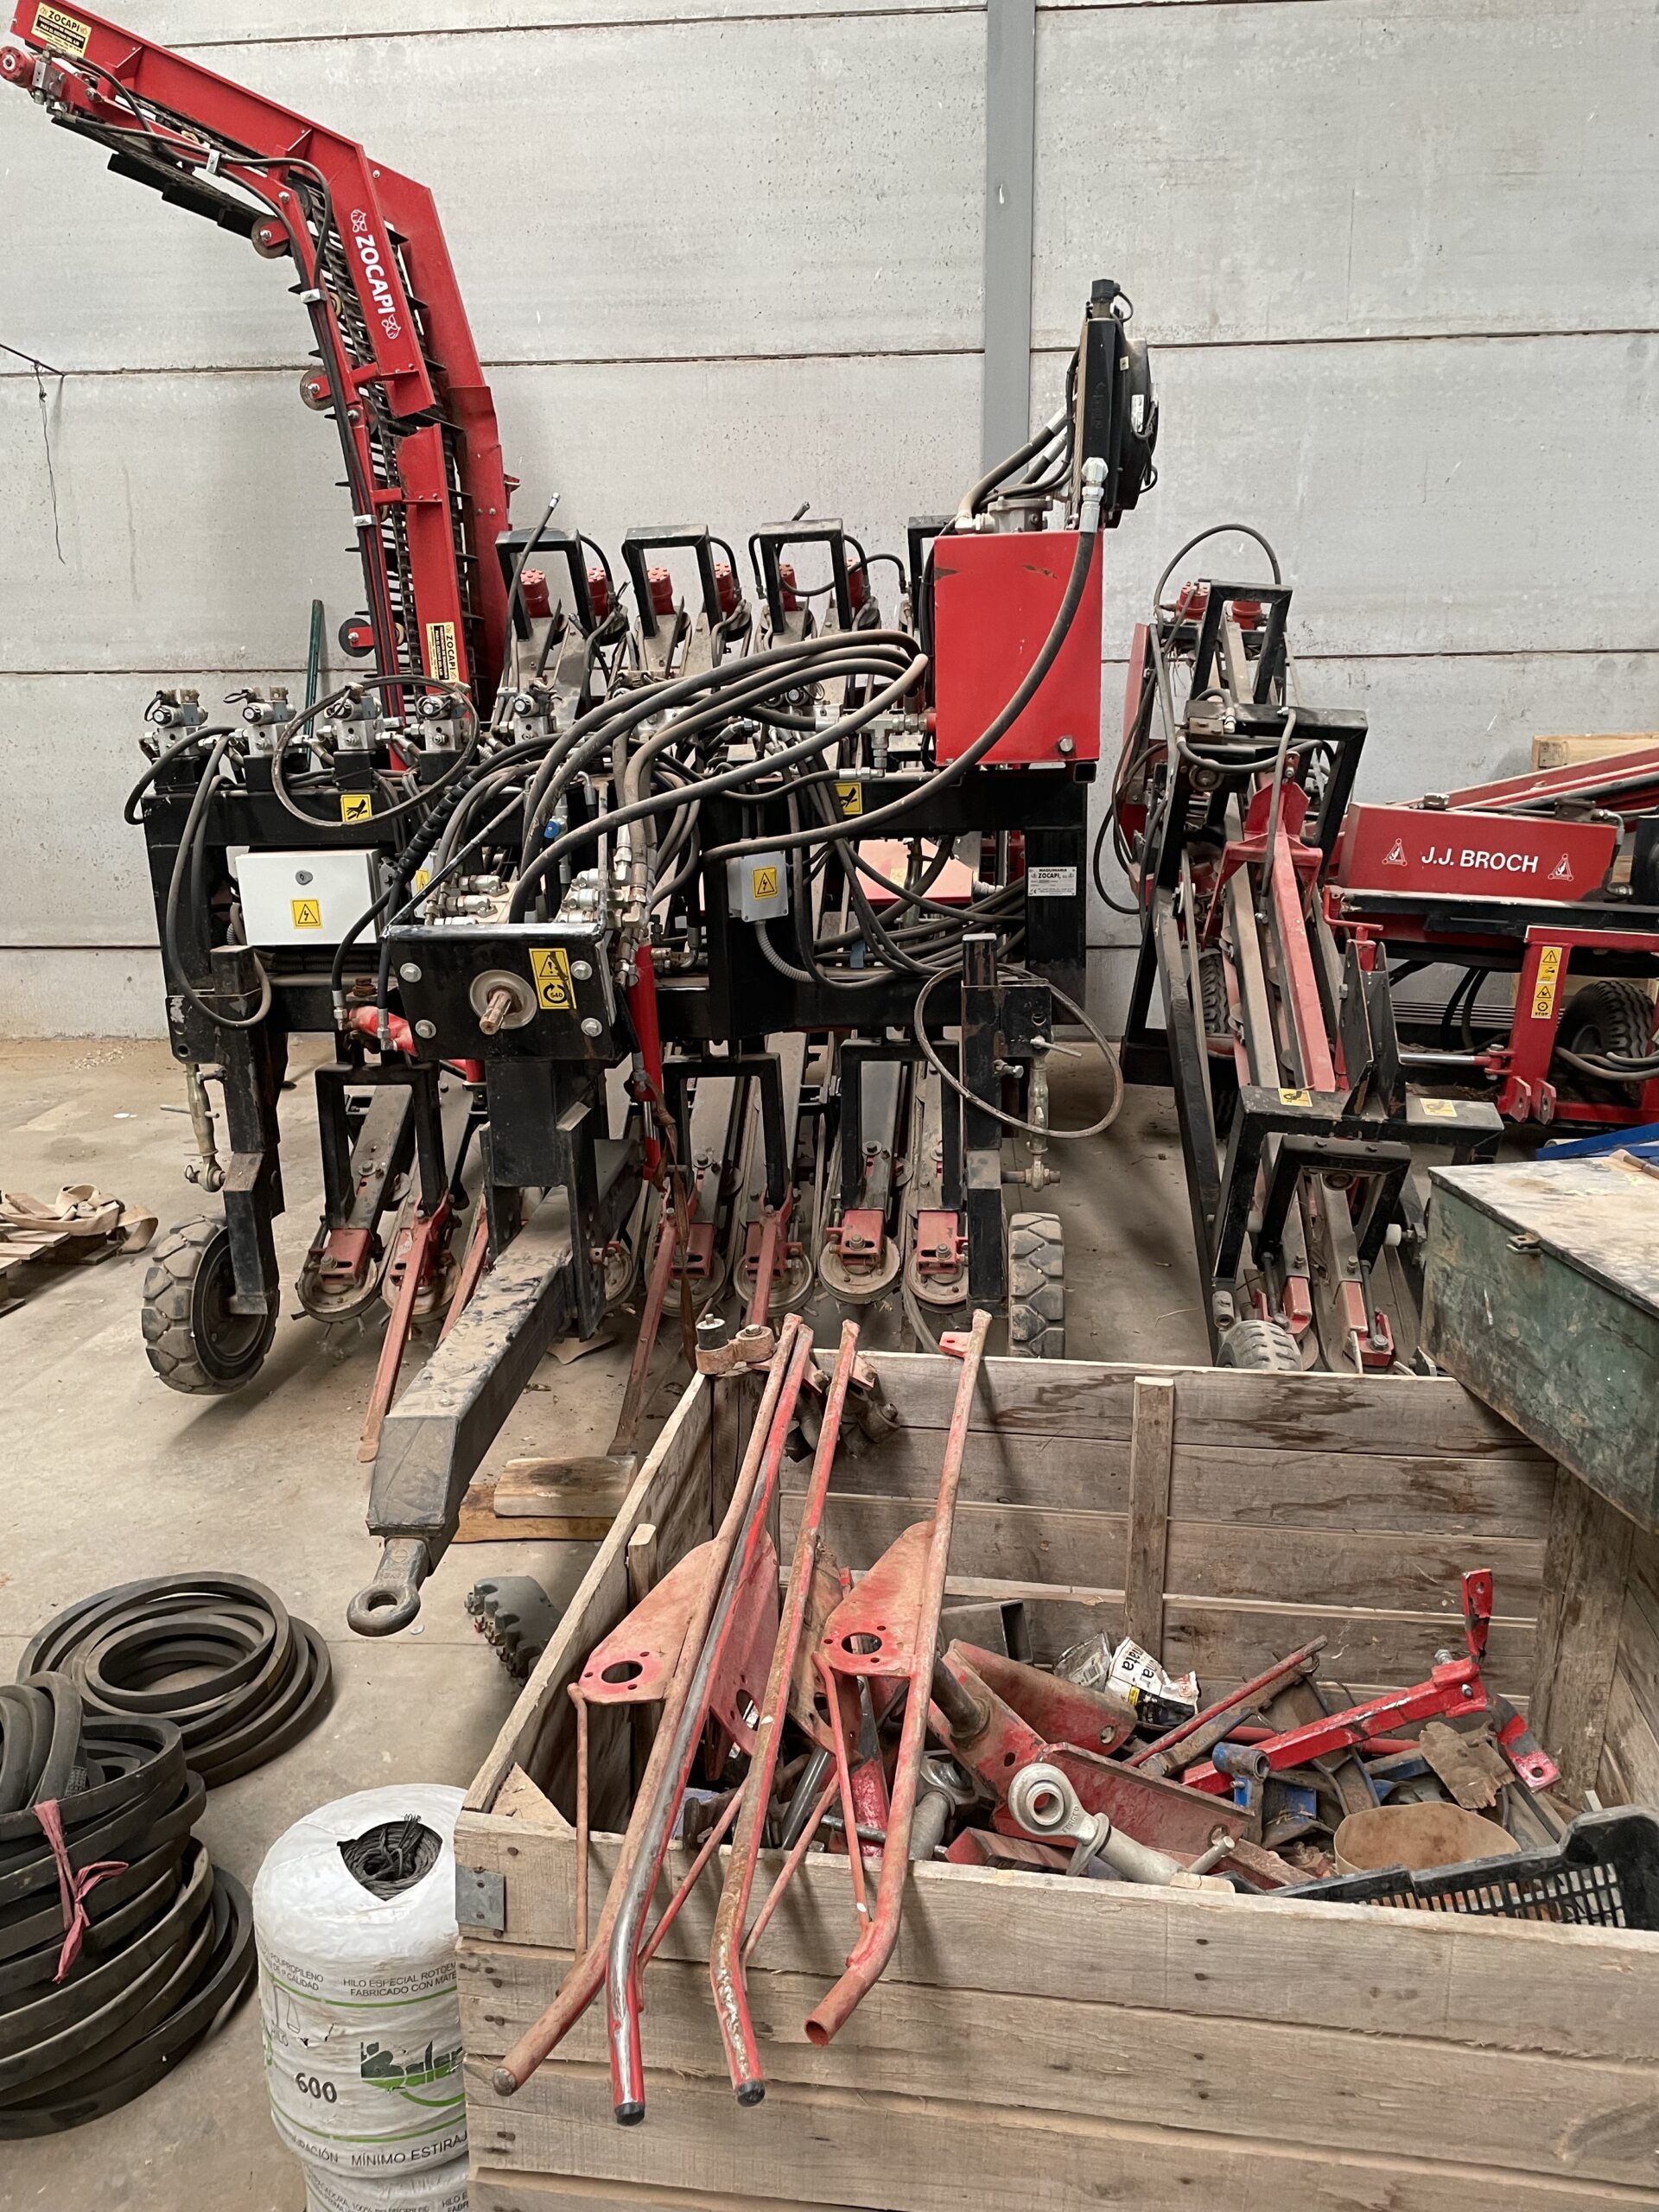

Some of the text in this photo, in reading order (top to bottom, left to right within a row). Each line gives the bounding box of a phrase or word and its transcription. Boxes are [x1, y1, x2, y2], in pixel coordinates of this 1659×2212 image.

[48, 10, 80, 32] ZOCAPI
[355, 234, 396, 315] ZOCAPI
[446, 635, 456, 671] ZOCAPI
[1421, 847, 1539, 874] J.J. BROCH
[287, 1972, 319, 1991] CALIDAD
[343, 1978, 366, 1988] HILO
[369, 1974, 418, 1988] ESPECIAL
[350, 1986, 409, 1997] FABRICADO
[410, 1979, 433, 1992] CON
[296, 2072, 338, 2103] 600
[351, 2152, 406, 2167] MÍNIMO
